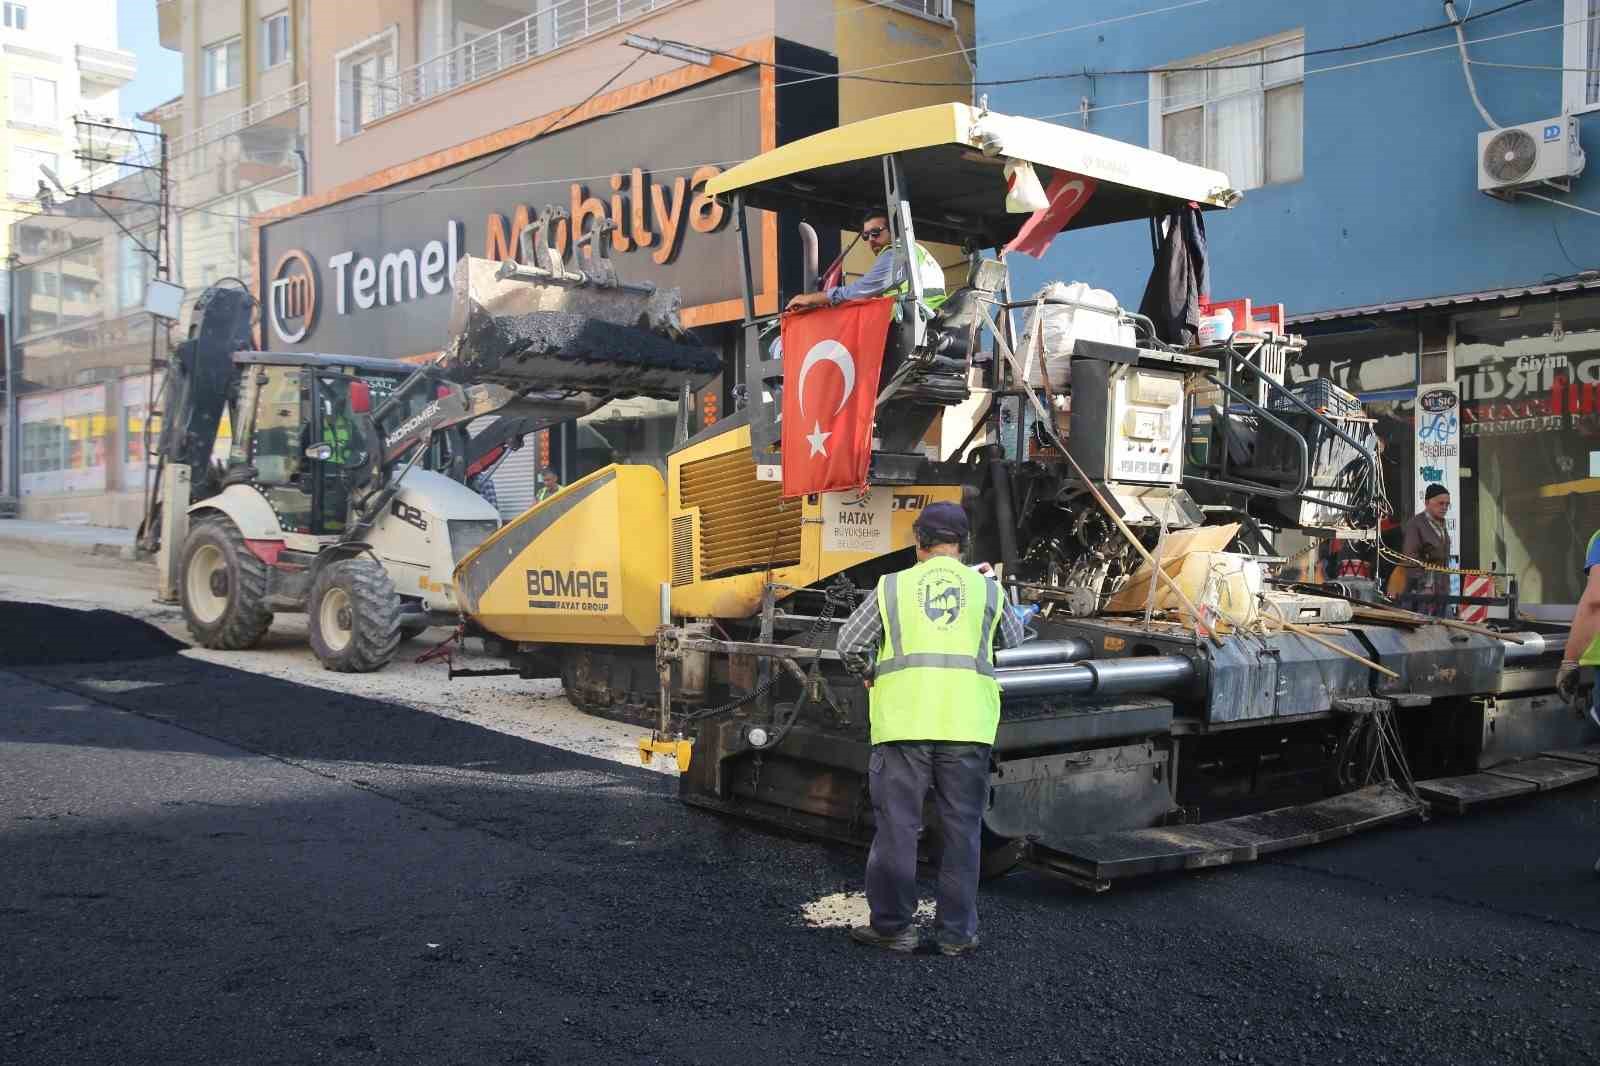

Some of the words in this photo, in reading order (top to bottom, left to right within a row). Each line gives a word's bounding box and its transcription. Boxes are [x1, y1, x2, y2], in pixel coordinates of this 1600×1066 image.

[328, 219, 458, 315] Temel
[839, 511, 875, 525] HATAY
[526, 569, 609, 598] BOMAG
[581, 601, 609, 611] GROUP
